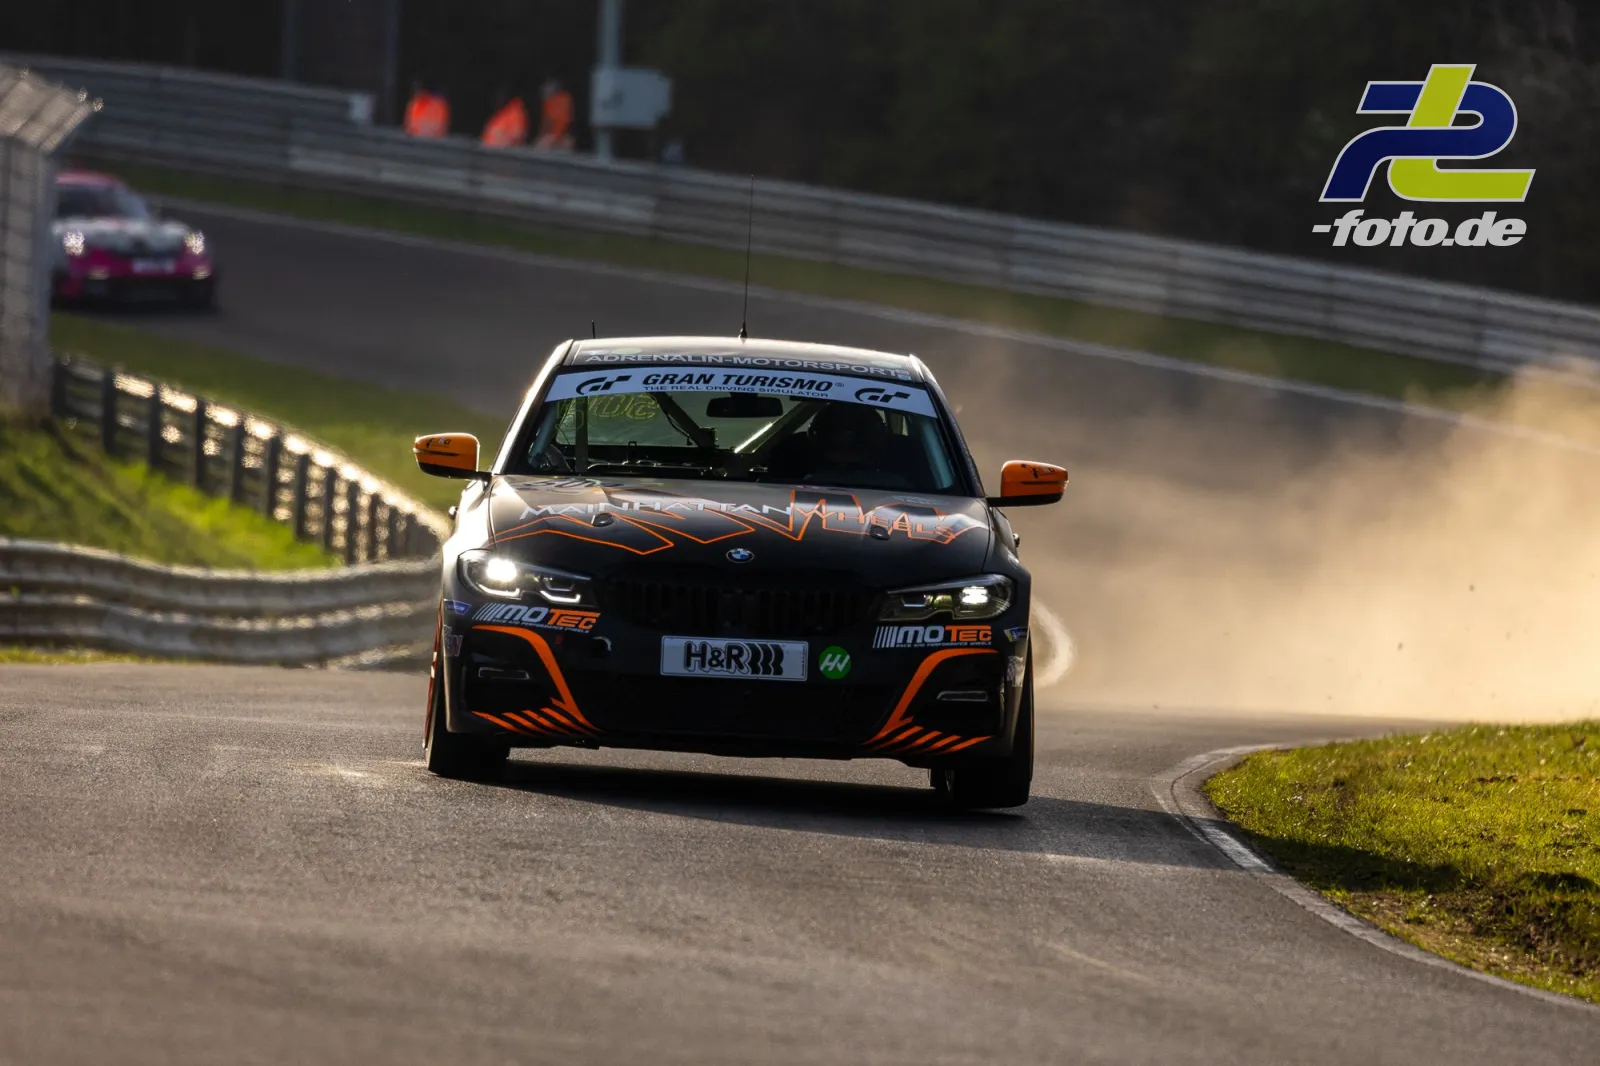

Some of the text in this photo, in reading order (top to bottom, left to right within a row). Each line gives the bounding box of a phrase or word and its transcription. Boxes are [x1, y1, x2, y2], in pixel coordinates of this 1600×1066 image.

[642, 373, 833, 392] GRAN TURISMO
[758, 388, 829, 398] SIMULATOR
[520, 501, 792, 520] MAINHATTAN
[683, 641, 750, 675] H&R
